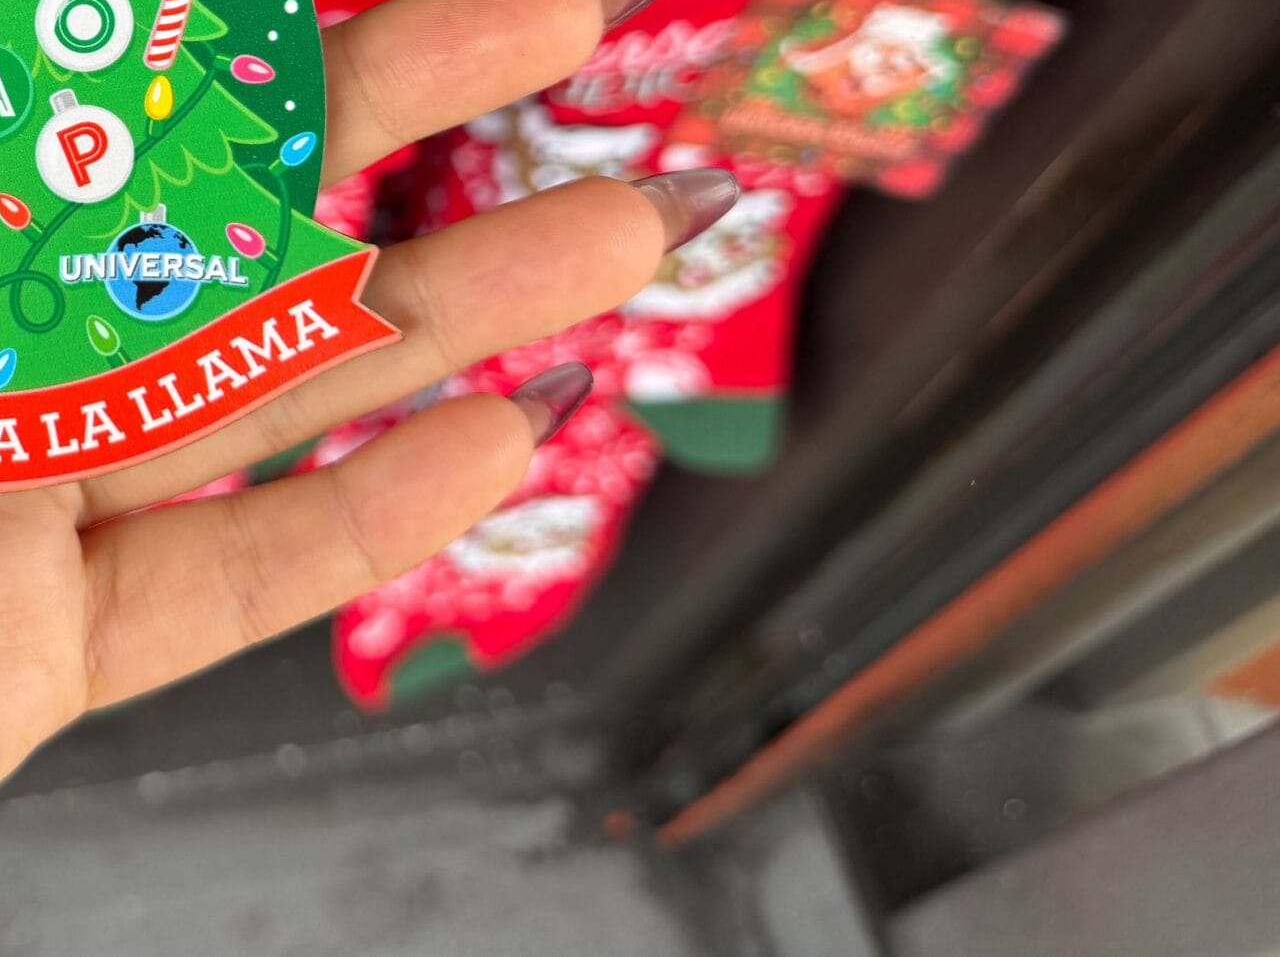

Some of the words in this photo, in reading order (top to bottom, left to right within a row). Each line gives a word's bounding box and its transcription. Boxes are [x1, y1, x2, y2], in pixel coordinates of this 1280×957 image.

[56, 120, 109, 188] P
[58, 252, 249, 287] UNIVERSAL
[39, 399, 126, 458] LA
[127, 299, 341, 435] LLAMA
